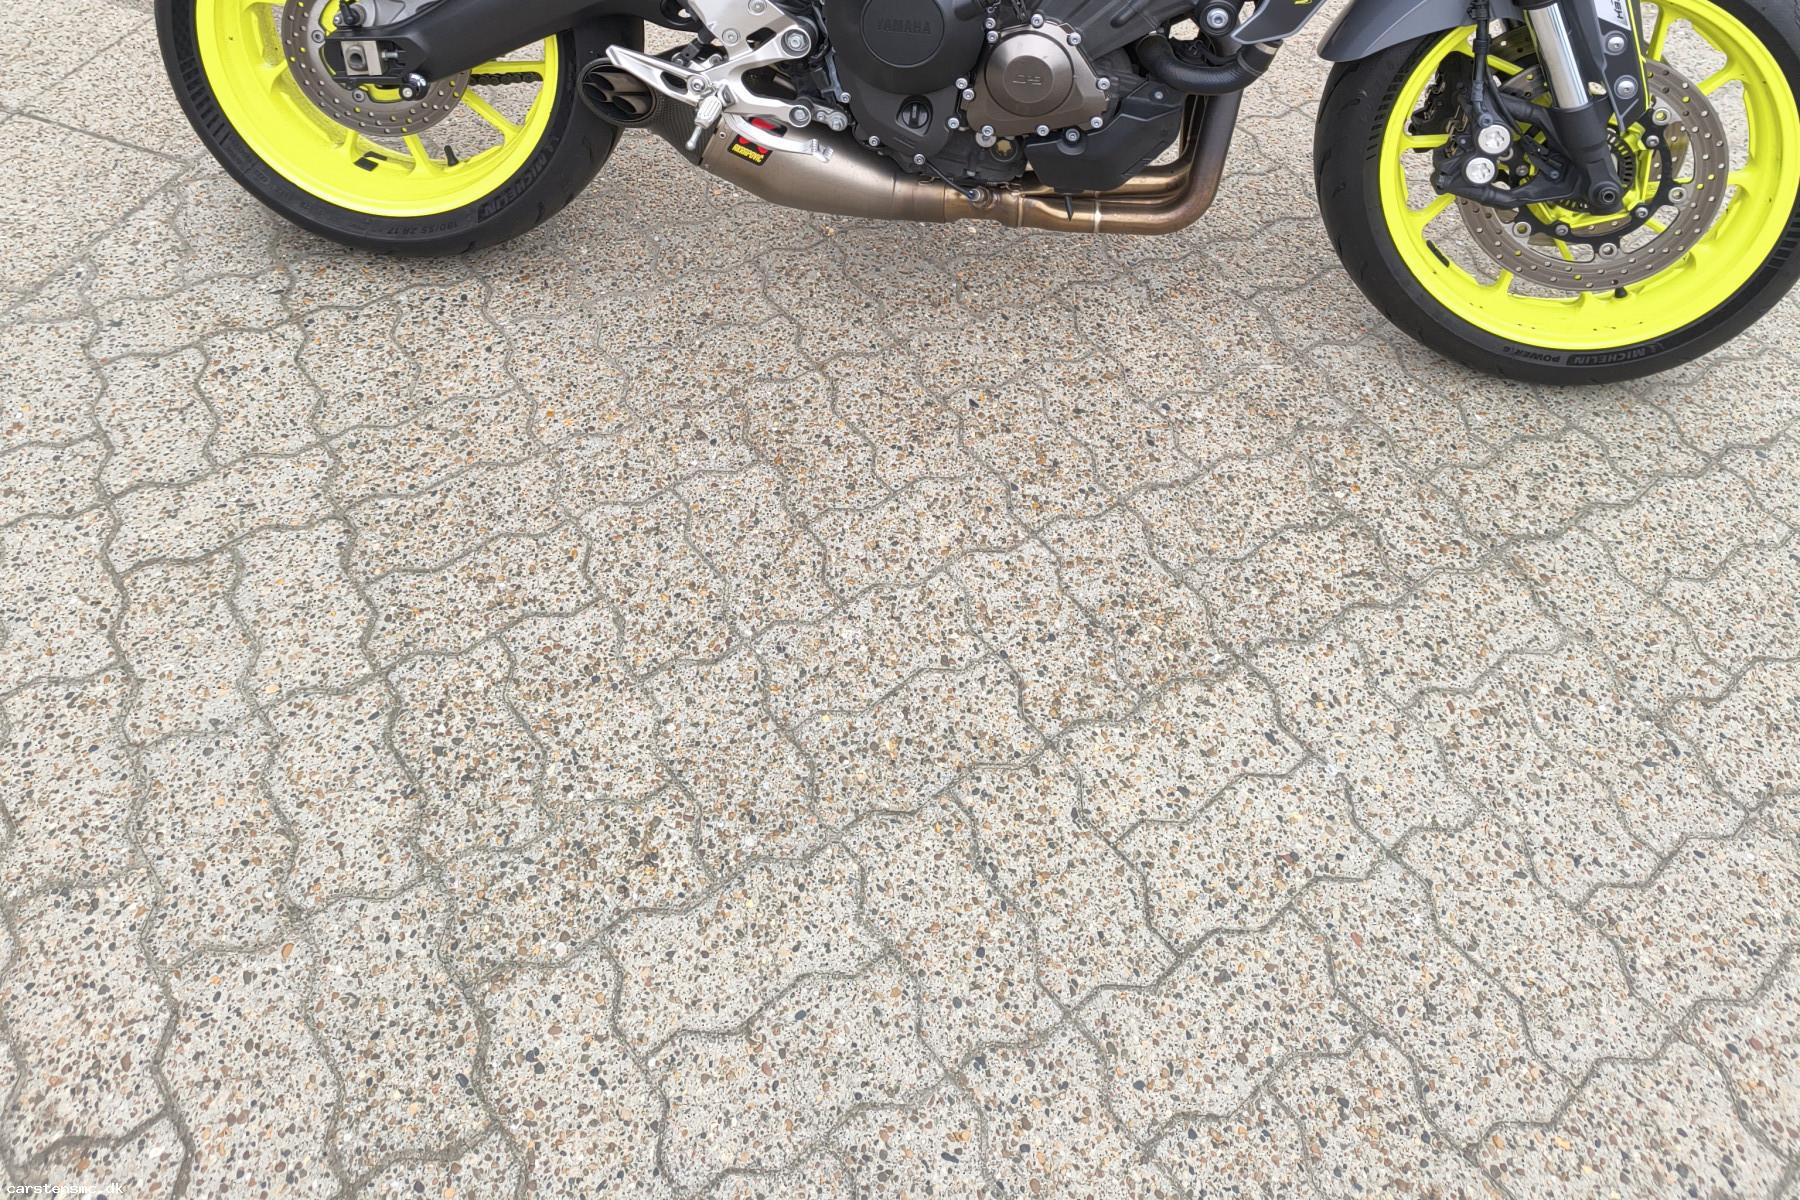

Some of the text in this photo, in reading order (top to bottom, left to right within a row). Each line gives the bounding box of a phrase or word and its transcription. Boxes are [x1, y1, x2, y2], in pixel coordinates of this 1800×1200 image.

[877, 17, 932, 35] YAMAHA
[483, 151, 548, 217] MICHELIN
[1515, 349, 1561, 363] POWER
[1573, 347, 1646, 365] MICHELIN
